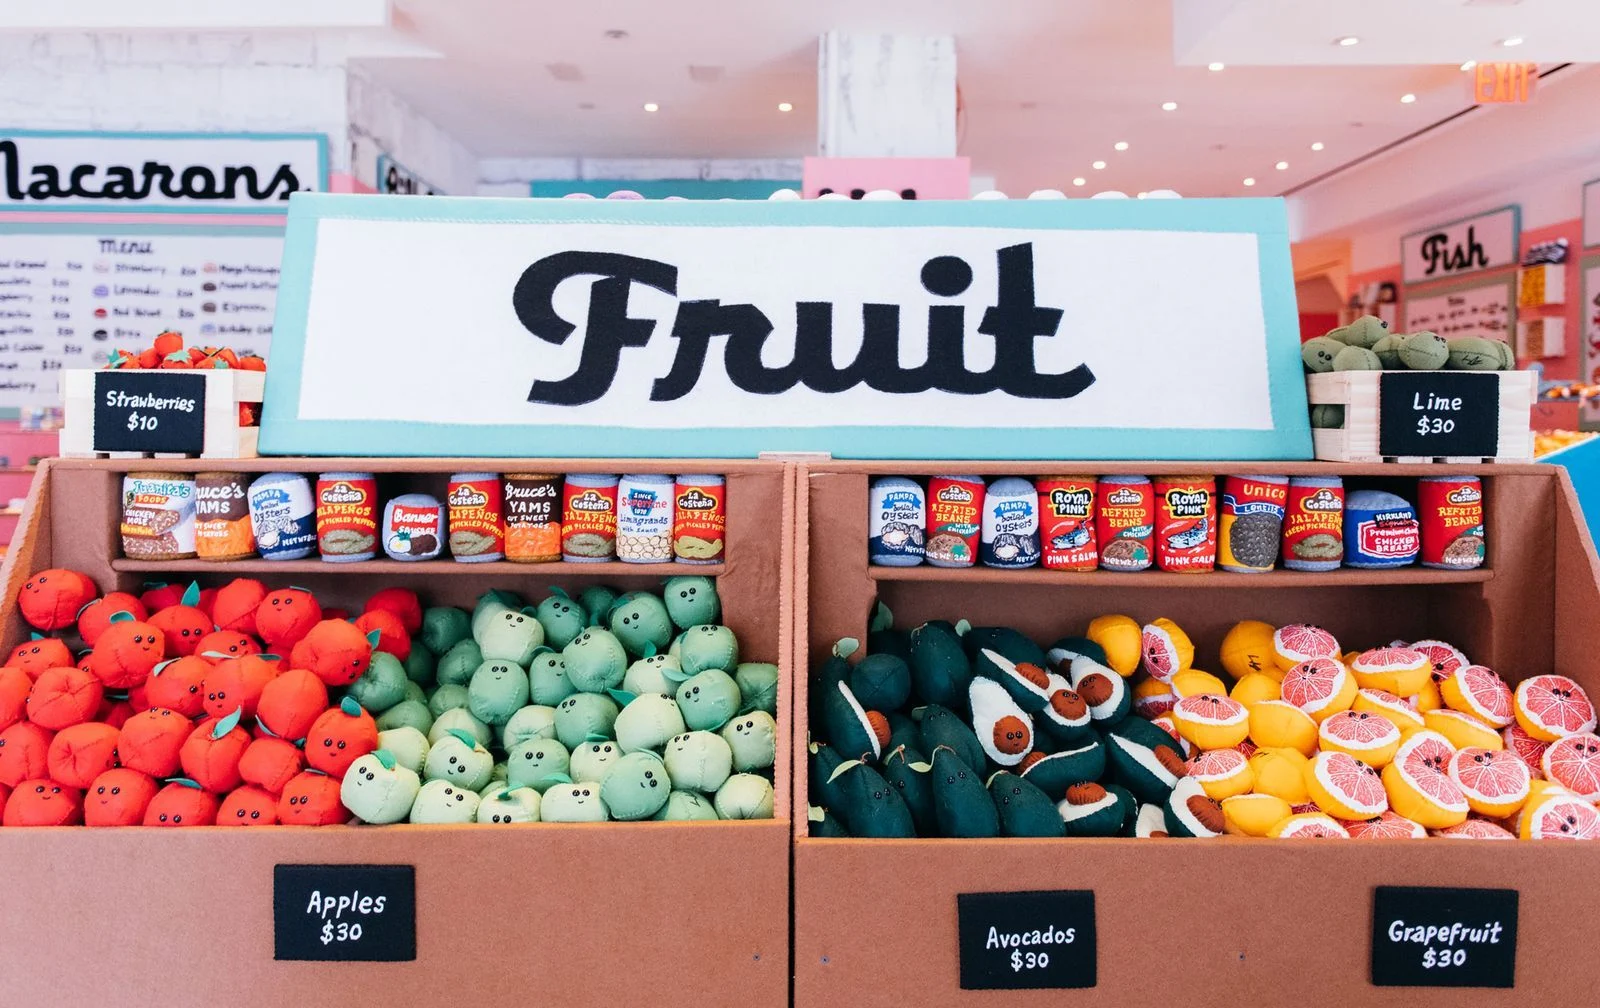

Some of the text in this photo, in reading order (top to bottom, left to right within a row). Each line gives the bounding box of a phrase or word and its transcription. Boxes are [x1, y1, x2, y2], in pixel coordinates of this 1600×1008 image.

[1475, 63, 1536, 103] EXIT
[0, 140, 302, 200] acarons
[1421, 224, 1490, 275] Fish
[512, 241, 1096, 407] Fruit
[106, 390, 196, 413] Strawberries
[1413, 391, 1462, 411] Lime
[127, 411, 158, 431] $10
[1416, 415, 1455, 436] $30
[133, 481, 191, 499] Juanita's
[334, 485, 348, 493] La
[458, 487, 470, 496] La
[505, 482, 557, 501] Bruce's
[1243, 483, 1286, 499] Unico
[138, 495, 167, 504] FOODS
[322, 491, 362, 502] Costeña
[584, 493, 597, 501] La
[688, 492, 699, 500] La
[888, 492, 915, 502] PAMPA
[1055, 492, 1090, 505] ROYAL
[1171, 492, 1206, 506] ROYAL
[1318, 491, 1332, 500] La
[509, 501, 551, 513] YAMS
[572, 500, 610, 510] Costeña
[679, 498, 713, 508] Costeña
[1000, 502, 1027, 511] PAMPA
[1059, 504, 1085, 514] PINK
[125, 509, 156, 520] CHICKEN
[449, 508, 498, 522] LAPEÑOS
[931, 503, 977, 516] REFRIED
[1101, 507, 1146, 518] REFRIED
[1177, 505, 1202, 514] PINK
[393, 508, 438, 524] Banner
[520, 514, 549, 522] SWEET
[564, 511, 617, 523] JALAPEÑO
[881, 511, 919, 521] Oysters
[935, 513, 971, 524] BEANS
[1376, 511, 1412, 521] KIRKLAND
[1444, 516, 1479, 528] BEANS
[995, 518, 1032, 532] Oysters
[1109, 518, 1142, 528] BEANS
[1375, 535, 1415, 545] CHICKEN
[1376, 544, 1413, 554] BREAST
[1047, 551, 1098, 565] PINK SALM
[1165, 553, 1216, 566] PINK SALM
[306, 890, 386, 920] Apples
[320, 918, 363, 946] $30
[985, 924, 1076, 949] Avocados
[1388, 919, 1503, 947] Grapefruit
[1010, 948, 1050, 973] $30
[1422, 946, 1467, 969] $30
